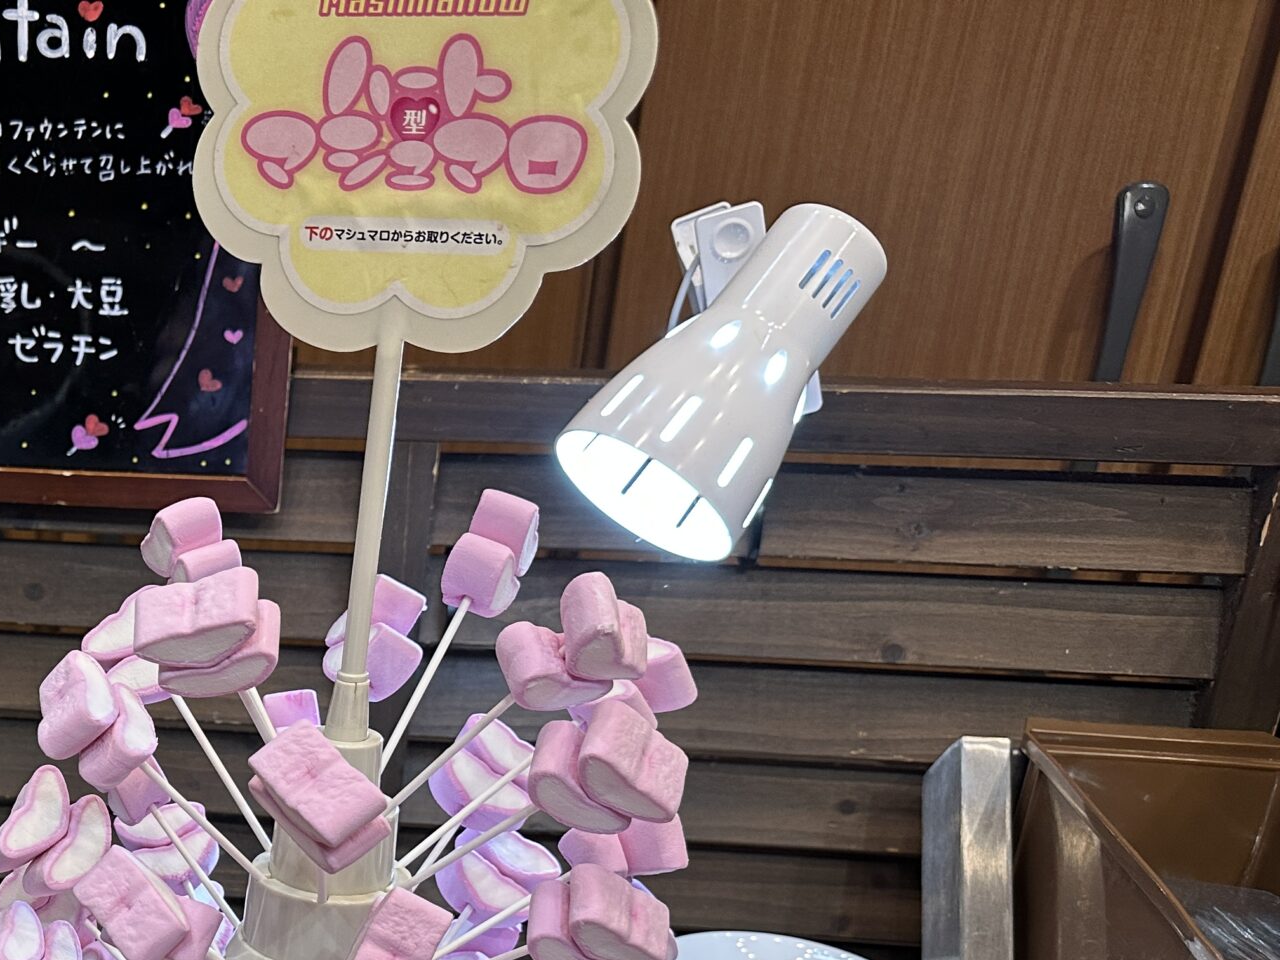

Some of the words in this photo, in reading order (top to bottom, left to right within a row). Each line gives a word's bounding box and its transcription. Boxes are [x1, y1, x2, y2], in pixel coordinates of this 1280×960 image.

[304, 226, 504, 247] 下のマシュマロからお取りください。
